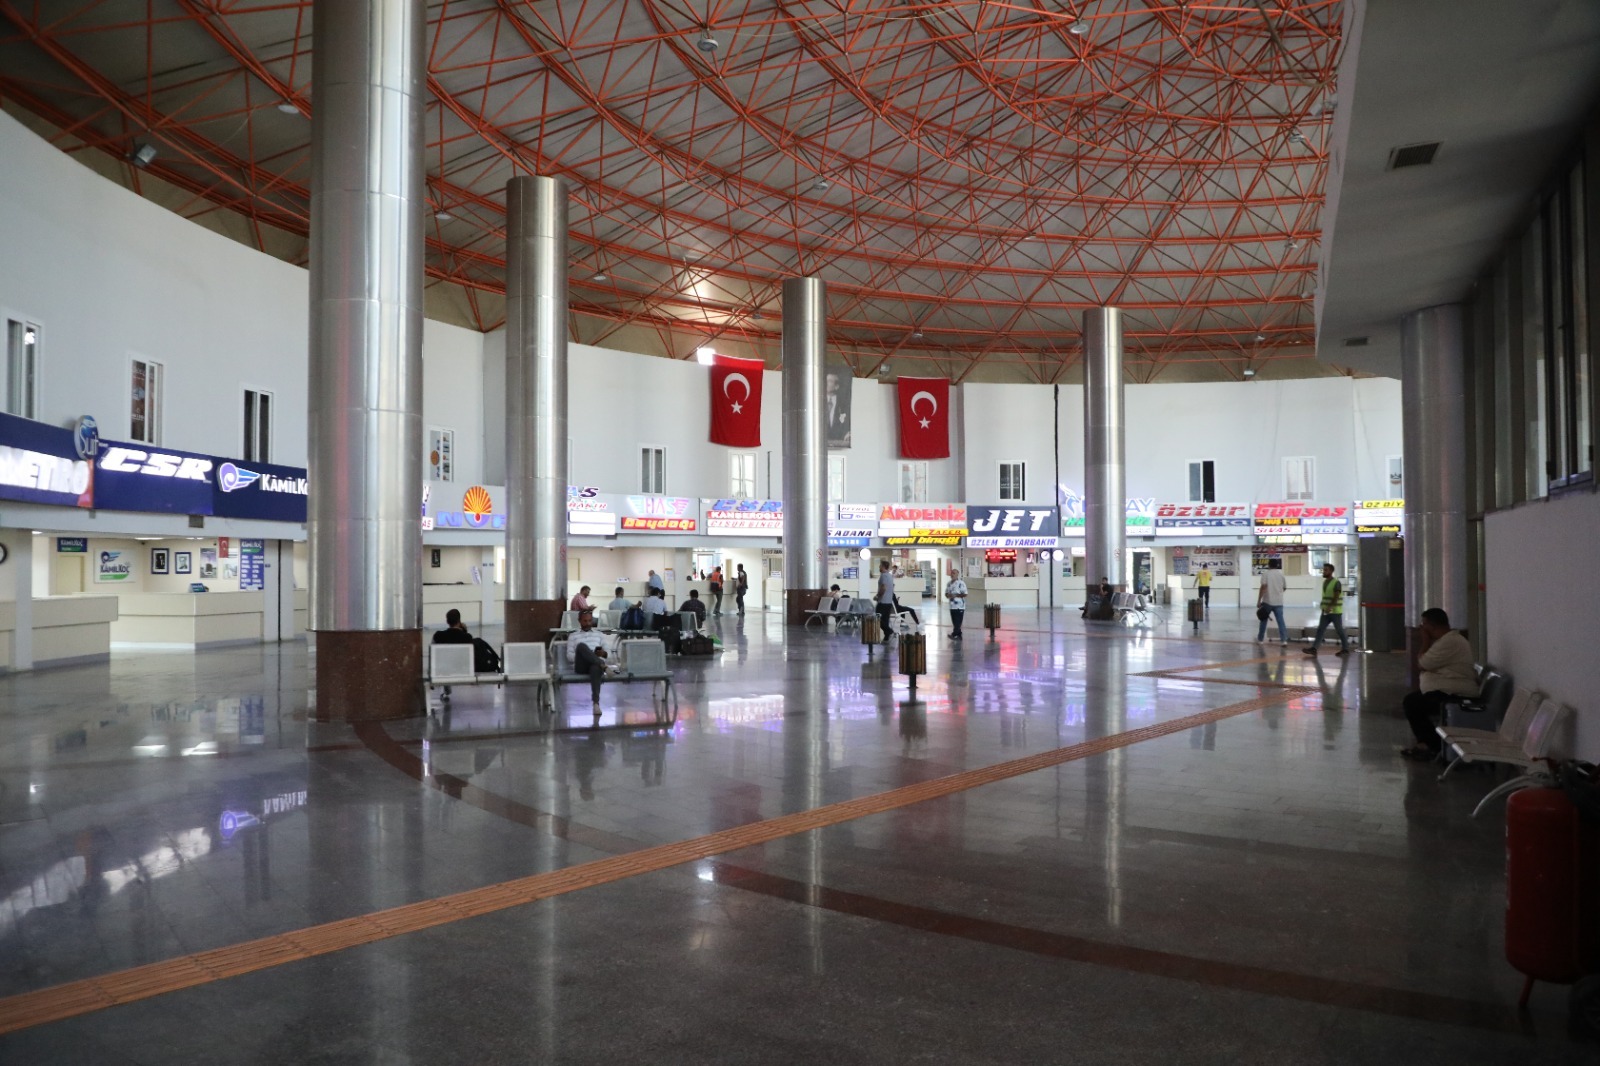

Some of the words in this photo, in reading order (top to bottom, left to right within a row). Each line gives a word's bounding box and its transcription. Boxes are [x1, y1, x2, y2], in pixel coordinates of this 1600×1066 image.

[100, 447, 213, 480] CSR
[880, 505, 966, 520] AKDENİZ
[1157, 503, 1245, 517] öztur
[972, 509, 1051, 532] JET
[1158, 519, 1248, 527] Isparta
[886, 537, 916, 545] yeni
